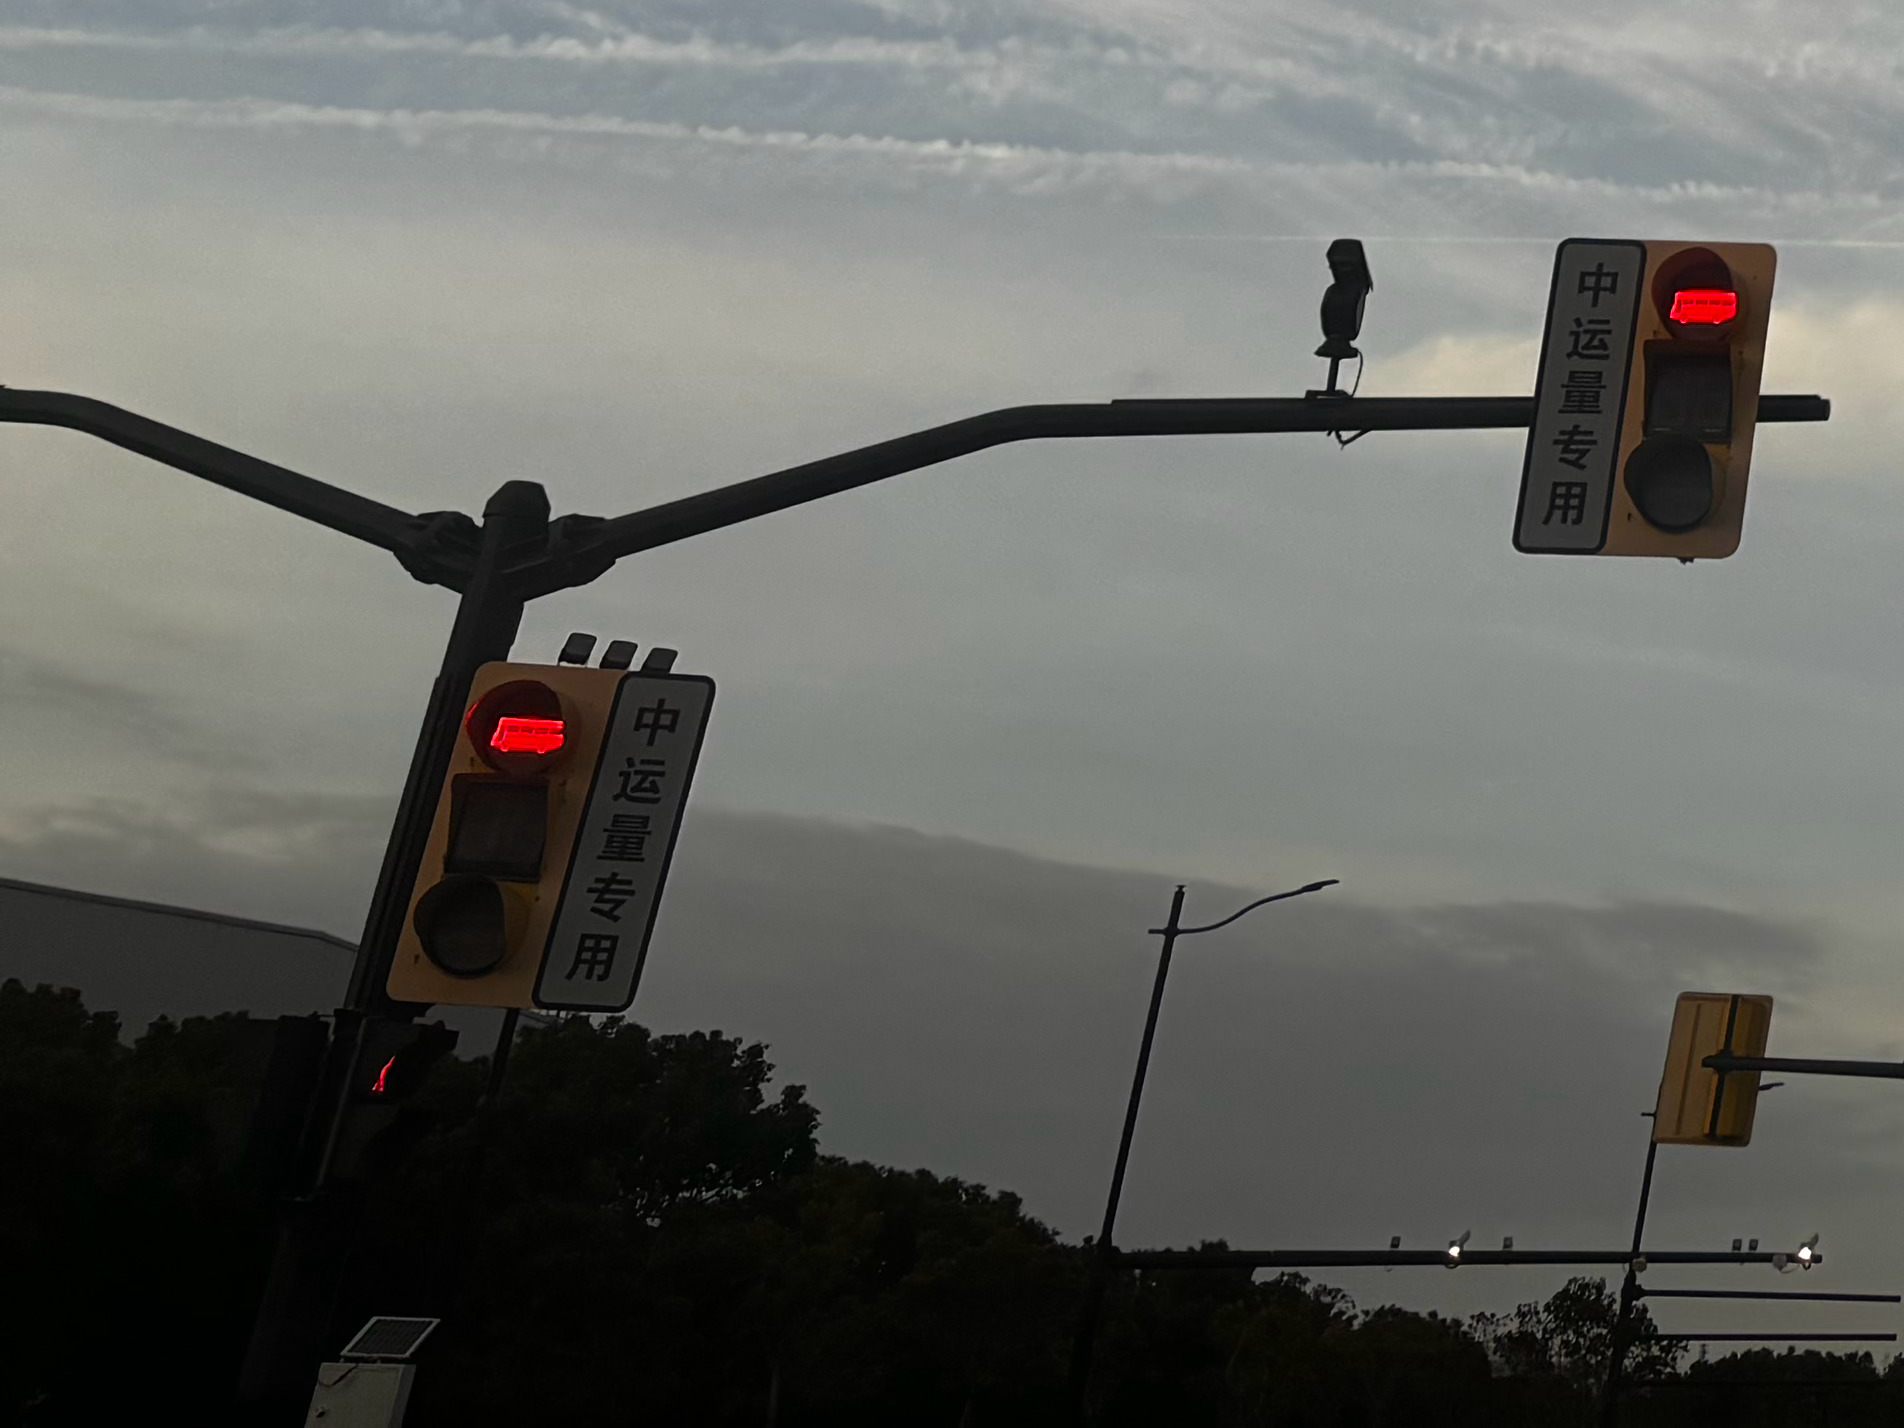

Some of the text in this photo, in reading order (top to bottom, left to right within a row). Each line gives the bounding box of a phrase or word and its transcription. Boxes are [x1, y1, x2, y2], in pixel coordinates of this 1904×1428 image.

[1542, 262, 1619, 527] 中运量专用
[565, 698, 680, 982] 中运量专用
